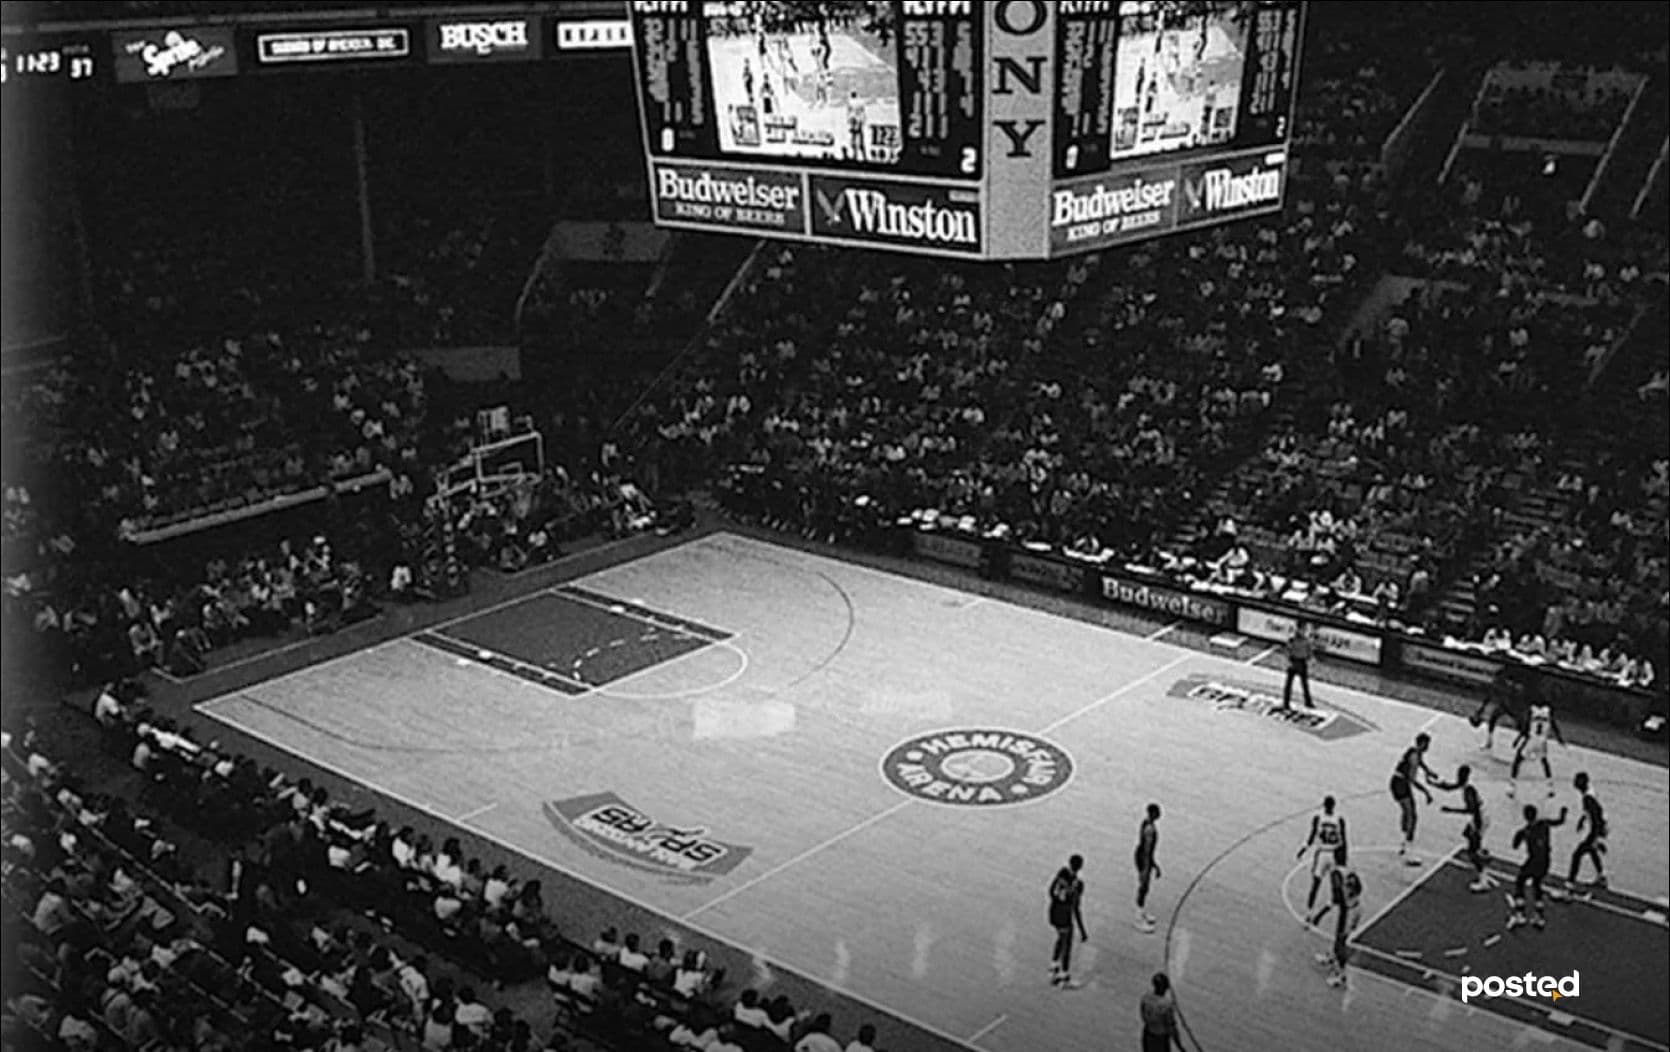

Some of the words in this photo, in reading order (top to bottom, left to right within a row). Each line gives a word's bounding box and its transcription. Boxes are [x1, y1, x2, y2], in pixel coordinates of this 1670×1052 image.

[441, 21, 528, 55] BUSCH
[657, 169, 799, 209] Budweiser
[1052, 179, 1175, 226] Budweiser
[1205, 166, 1280, 211] Winston
[675, 202, 712, 217] KING
[714, 206, 732, 220] OF
[845, 187, 976, 243] Winston
[1102, 576, 1228, 624] Budweiser
[896, 762, 1002, 802] ARENA
